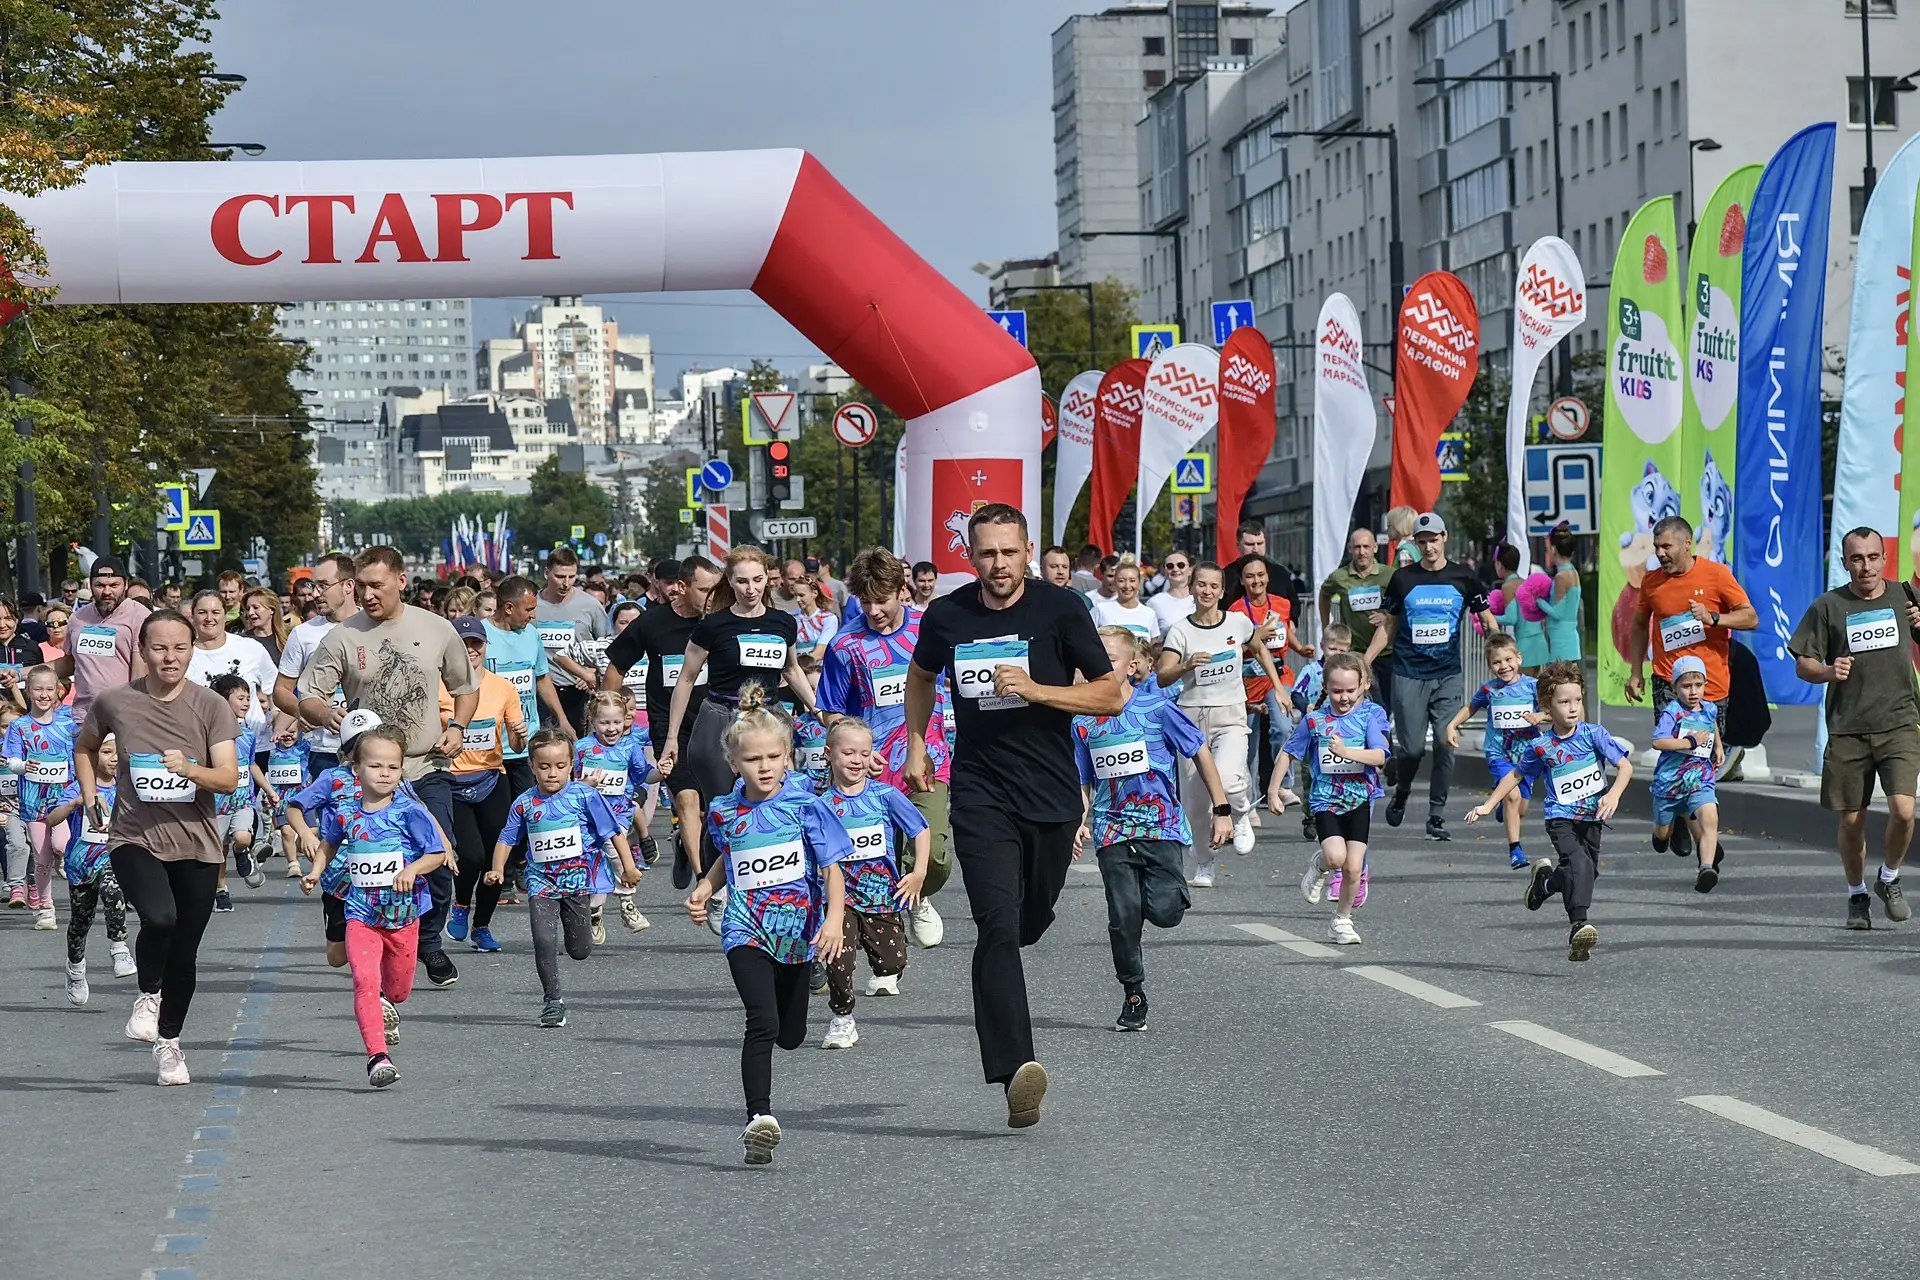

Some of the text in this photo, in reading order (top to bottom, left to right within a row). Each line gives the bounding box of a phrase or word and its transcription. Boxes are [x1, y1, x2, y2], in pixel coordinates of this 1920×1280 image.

[210, 191, 574, 266] СТАРТ
[1623, 304, 1639, 325] 3+
[1404, 342, 1460, 381] АРАФОН
[1620, 376, 1652, 400] KIDS
[1146, 388, 1204, 424] ПЕРМСКИЙ
[768, 522, 810, 535] СТОП
[1351, 596, 1379, 606] 2037
[540, 633, 572, 641] 2100
[1415, 628, 1447, 637] 2128
[1664, 624, 1701, 644] 2036
[1851, 627, 1896, 643] 2092
[79, 638, 113, 649] 2059
[745, 648, 782, 659] 2119
[961, 669, 992, 683] 20
[1200, 664, 1234, 678] 2110
[463, 733, 490, 744] 131
[1095, 749, 1144, 769] 2098
[270, 769, 298, 778] 2166
[135, 777, 190, 790] 2014
[1560, 770, 1602, 795] 2070
[534, 835, 576, 852] 2131
[350, 860, 398, 875] 2014
[737, 851, 800, 877] 2024
